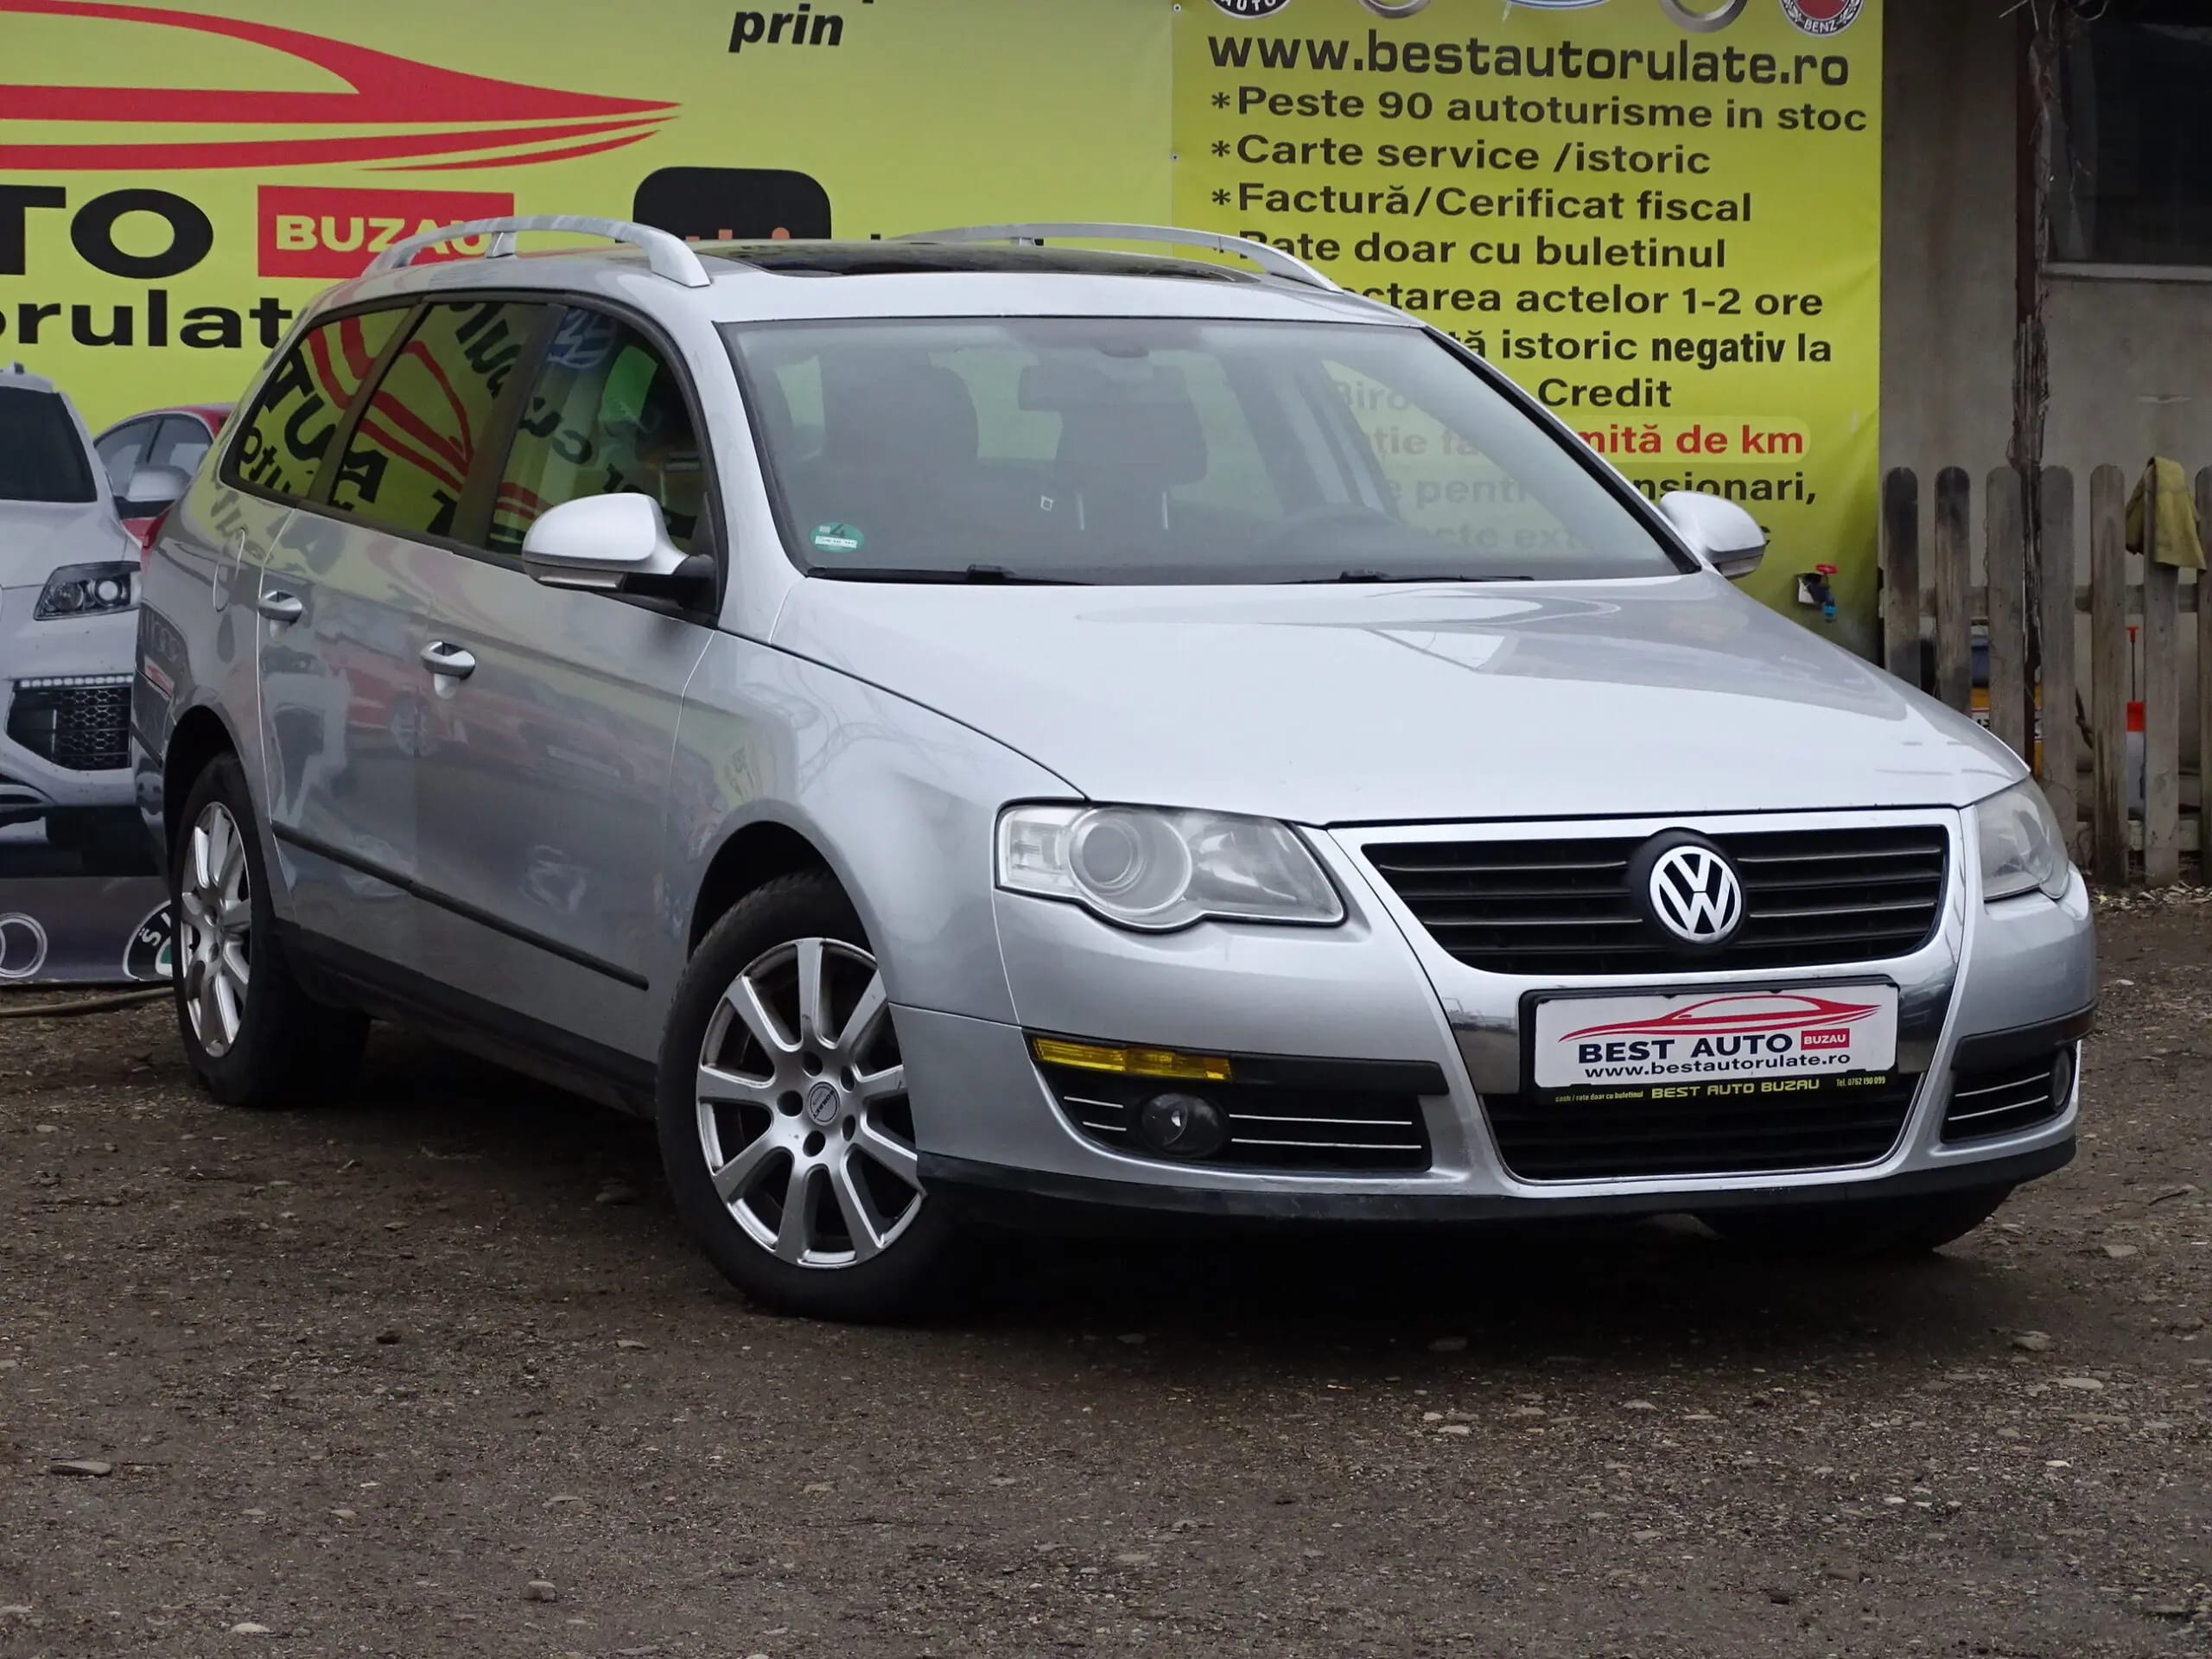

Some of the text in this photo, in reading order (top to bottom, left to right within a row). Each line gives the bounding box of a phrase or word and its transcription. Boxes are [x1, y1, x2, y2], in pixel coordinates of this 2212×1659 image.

[728, 3, 843, 53] prin
[1803, 19, 1838, 33] BENZ
[1207, 29, 1849, 86] www.bestautorulate.ro
[1378, 91, 1433, 119] 90
[1447, 94, 1713, 127] autoturisme
[1726, 99, 1763, 129] in
[1777, 103, 1867, 131] stoc
[1377, 138, 1540, 169] service
[1553, 142, 1711, 174] /istoric
[1637, 189, 1751, 222] fiscal
[1354, 232, 1456, 263] doar
[1469, 240, 1521, 264] cu
[1535, 235, 1726, 268] buletinul
[1516, 283, 1669, 314] actelor
[1682, 287, 1742, 315] 1-2
[1754, 292, 1823, 316] ore
[1502, 329, 1637, 360] istoric
[1650, 331, 1786, 370] negativ
[1797, 333, 1832, 362] la
[1537, 378, 1672, 408] Credit
[1675, 424, 1728, 454] de
[1741, 424, 1803, 454] km
[1578, 1033, 1847, 1065] BEST AUTO BUZAU
[1585, 1052, 1851, 1078] www.bestautorulate.ro
[1651, 1086, 1701, 1099] BEST
[1707, 1083, 1755, 1096] AUTO
[1761, 1079, 1820, 1093] BUZAU
